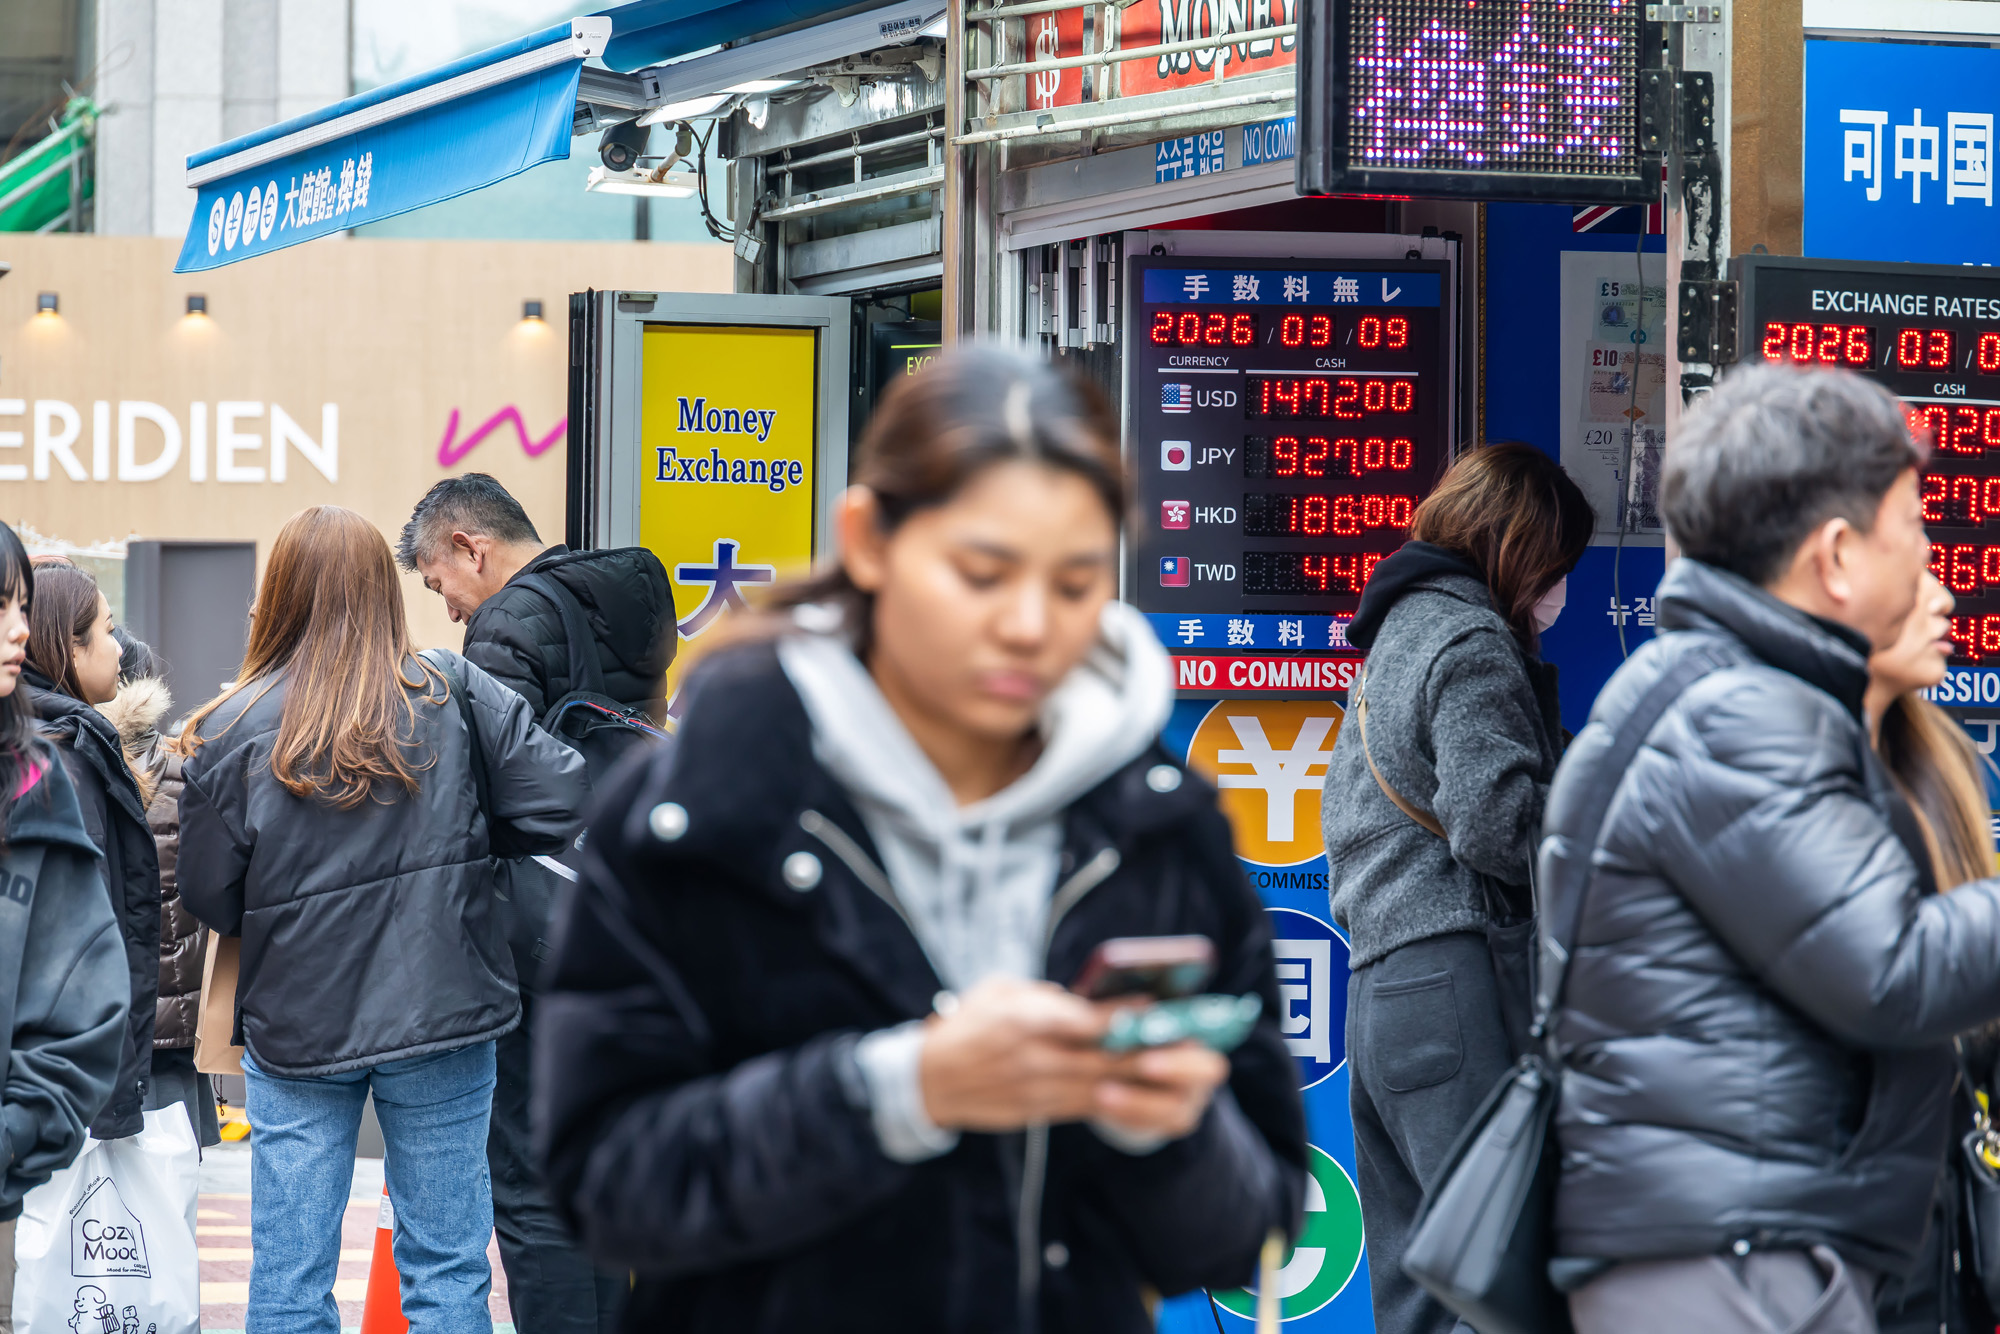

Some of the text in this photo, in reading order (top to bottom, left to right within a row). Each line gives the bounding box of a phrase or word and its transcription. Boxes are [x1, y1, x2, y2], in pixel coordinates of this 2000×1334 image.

[1243, 128, 1261, 161] NO
[1156, 130, 1224, 183] 수수료 없음
[1839, 108, 1994, 206] 可中国
[1601, 282, 1619, 297] £5
[1811, 289, 2000, 320] EXCHANGE RATES
[1152, 313, 1252, 345] 2026
[1281, 315, 1331, 347] 03
[1360, 317, 1408, 348] 09
[1763, 323, 1869, 362] 2026
[1899, 330, 1950, 368] 03
[1168, 355, 1230, 367] CURRENCY
[1315, 357, 1346, 369] CASH
[1592, 349, 1618, 366] £10
[1196, 390, 1237, 408] USD
[1933, 383, 1966, 395] CASH
[677, 397, 776, 442] Money
[1583, 429, 1613, 446] £20
[1197, 447, 1236, 466] JPY
[655, 447, 804, 493] Exchange
[1194, 506, 1237, 525] HKD
[1194, 564, 1236, 582] TWD
[1179, 660, 1217, 687] NO
[1921, 671, 2000, 703] ISSIO
